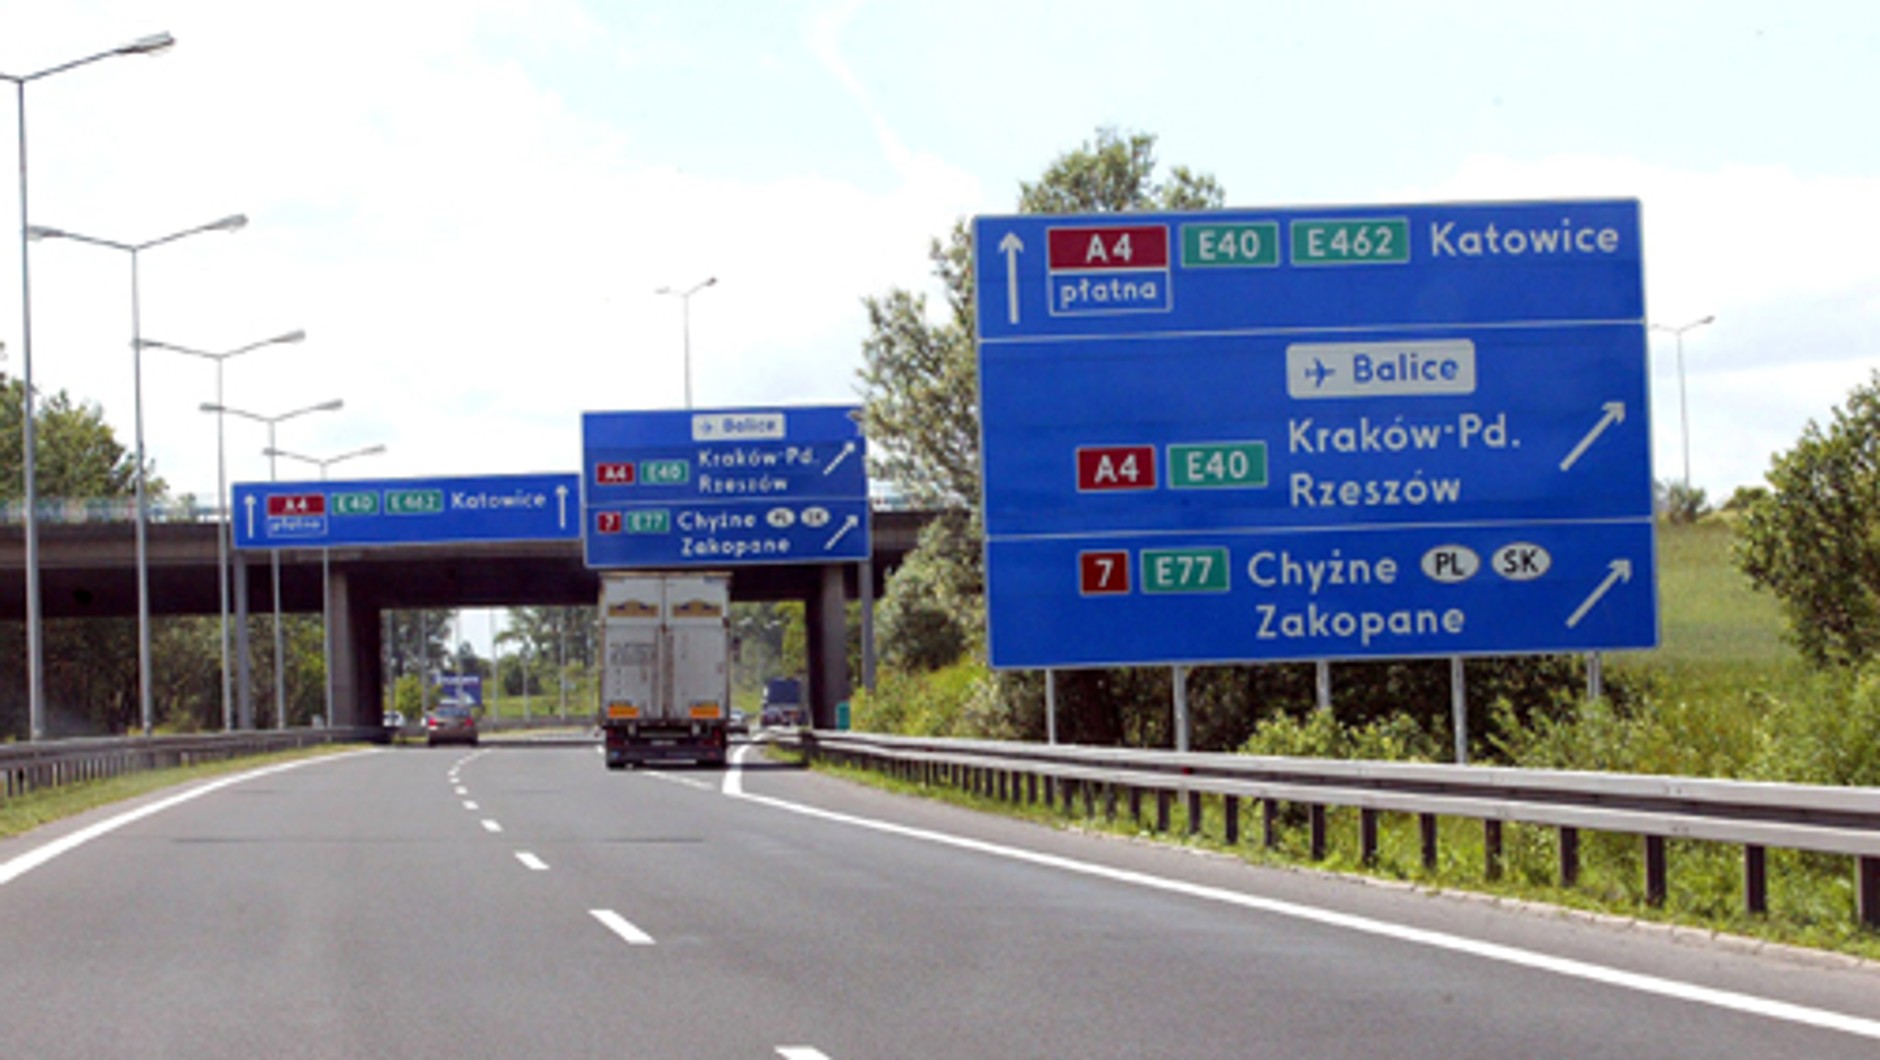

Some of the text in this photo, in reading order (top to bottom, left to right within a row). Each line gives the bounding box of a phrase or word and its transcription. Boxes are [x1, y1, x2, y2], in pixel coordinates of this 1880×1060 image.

[1085, 220, 1619, 263] A4 E40 E462 Katowice
[1060, 277, 1157, 308] płatna
[1353, 353, 1459, 384] Balice
[722, 418, 776, 433] Balice
[605, 465, 681, 479] A4 E40
[1094, 449, 1249, 483] A4 E40
[700, 475, 787, 492] Rzeszów
[1291, 472, 1459, 507] Rzeszów
[451, 490, 546, 509] Katowice
[681, 538, 790, 556] Zakopane
[1095, 548, 1538, 592] 7 E77 Chyżne PL SK
[1256, 604, 1464, 645] Zakopane
